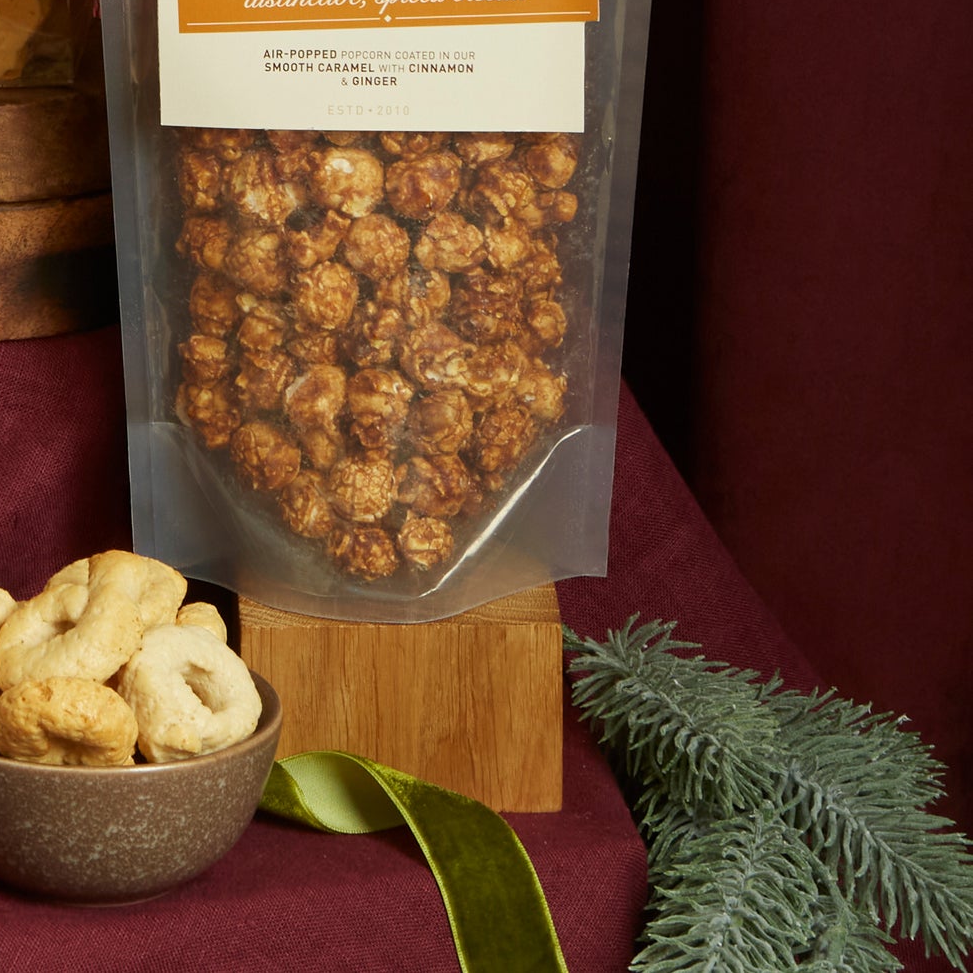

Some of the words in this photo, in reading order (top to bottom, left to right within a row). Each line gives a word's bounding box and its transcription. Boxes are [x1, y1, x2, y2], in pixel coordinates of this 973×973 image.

[263, 49, 337, 59] AIR-POPPED
[341, 50, 392, 60] POPCORN
[395, 50, 435, 60] COATED
[438, 51, 450, 60] IN
[453, 51, 475, 60] OUR
[264, 62, 314, 73] SMOOTH
[318, 62, 375, 73] CARAMEL
[378, 64, 405, 73] WITH
[409, 63, 474, 73] CINNAMON
[341, 77, 348, 86] &
[352, 76, 397, 86] GINGER
